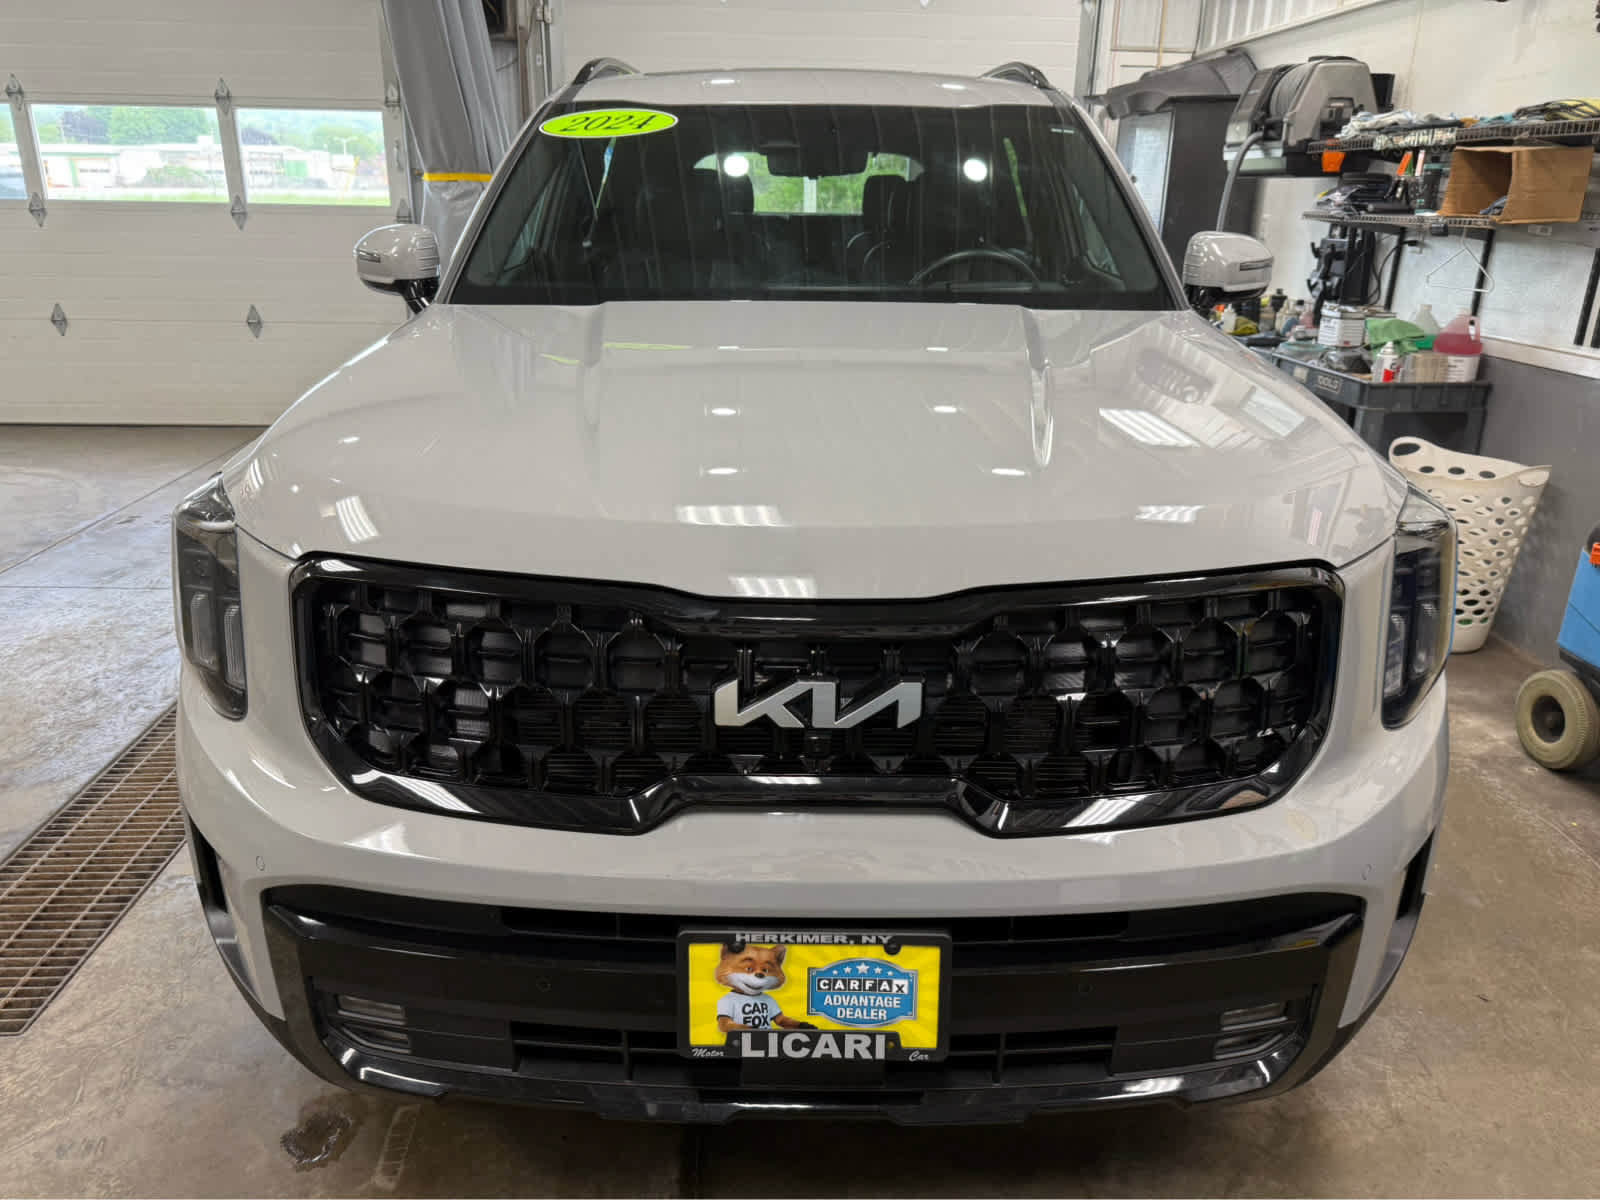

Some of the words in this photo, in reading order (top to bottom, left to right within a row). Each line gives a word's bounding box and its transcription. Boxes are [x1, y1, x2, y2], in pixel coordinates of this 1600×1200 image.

[560, 115, 657, 132] 2024
[714, 679, 923, 728] KIA
[735, 932, 854, 945] HERKIMER,
[861, 934, 893, 944] NY
[816, 977, 909, 994] CARFAX
[742, 1002, 768, 1015] CAR
[823, 995, 901, 1009] ADVANTAGE
[836, 1008, 887, 1021] DEALER
[742, 1015, 769, 1028] FOX
[692, 1047, 724, 1057] Motor
[741, 1032, 886, 1060] LICARI
[909, 1050, 929, 1062] Car
